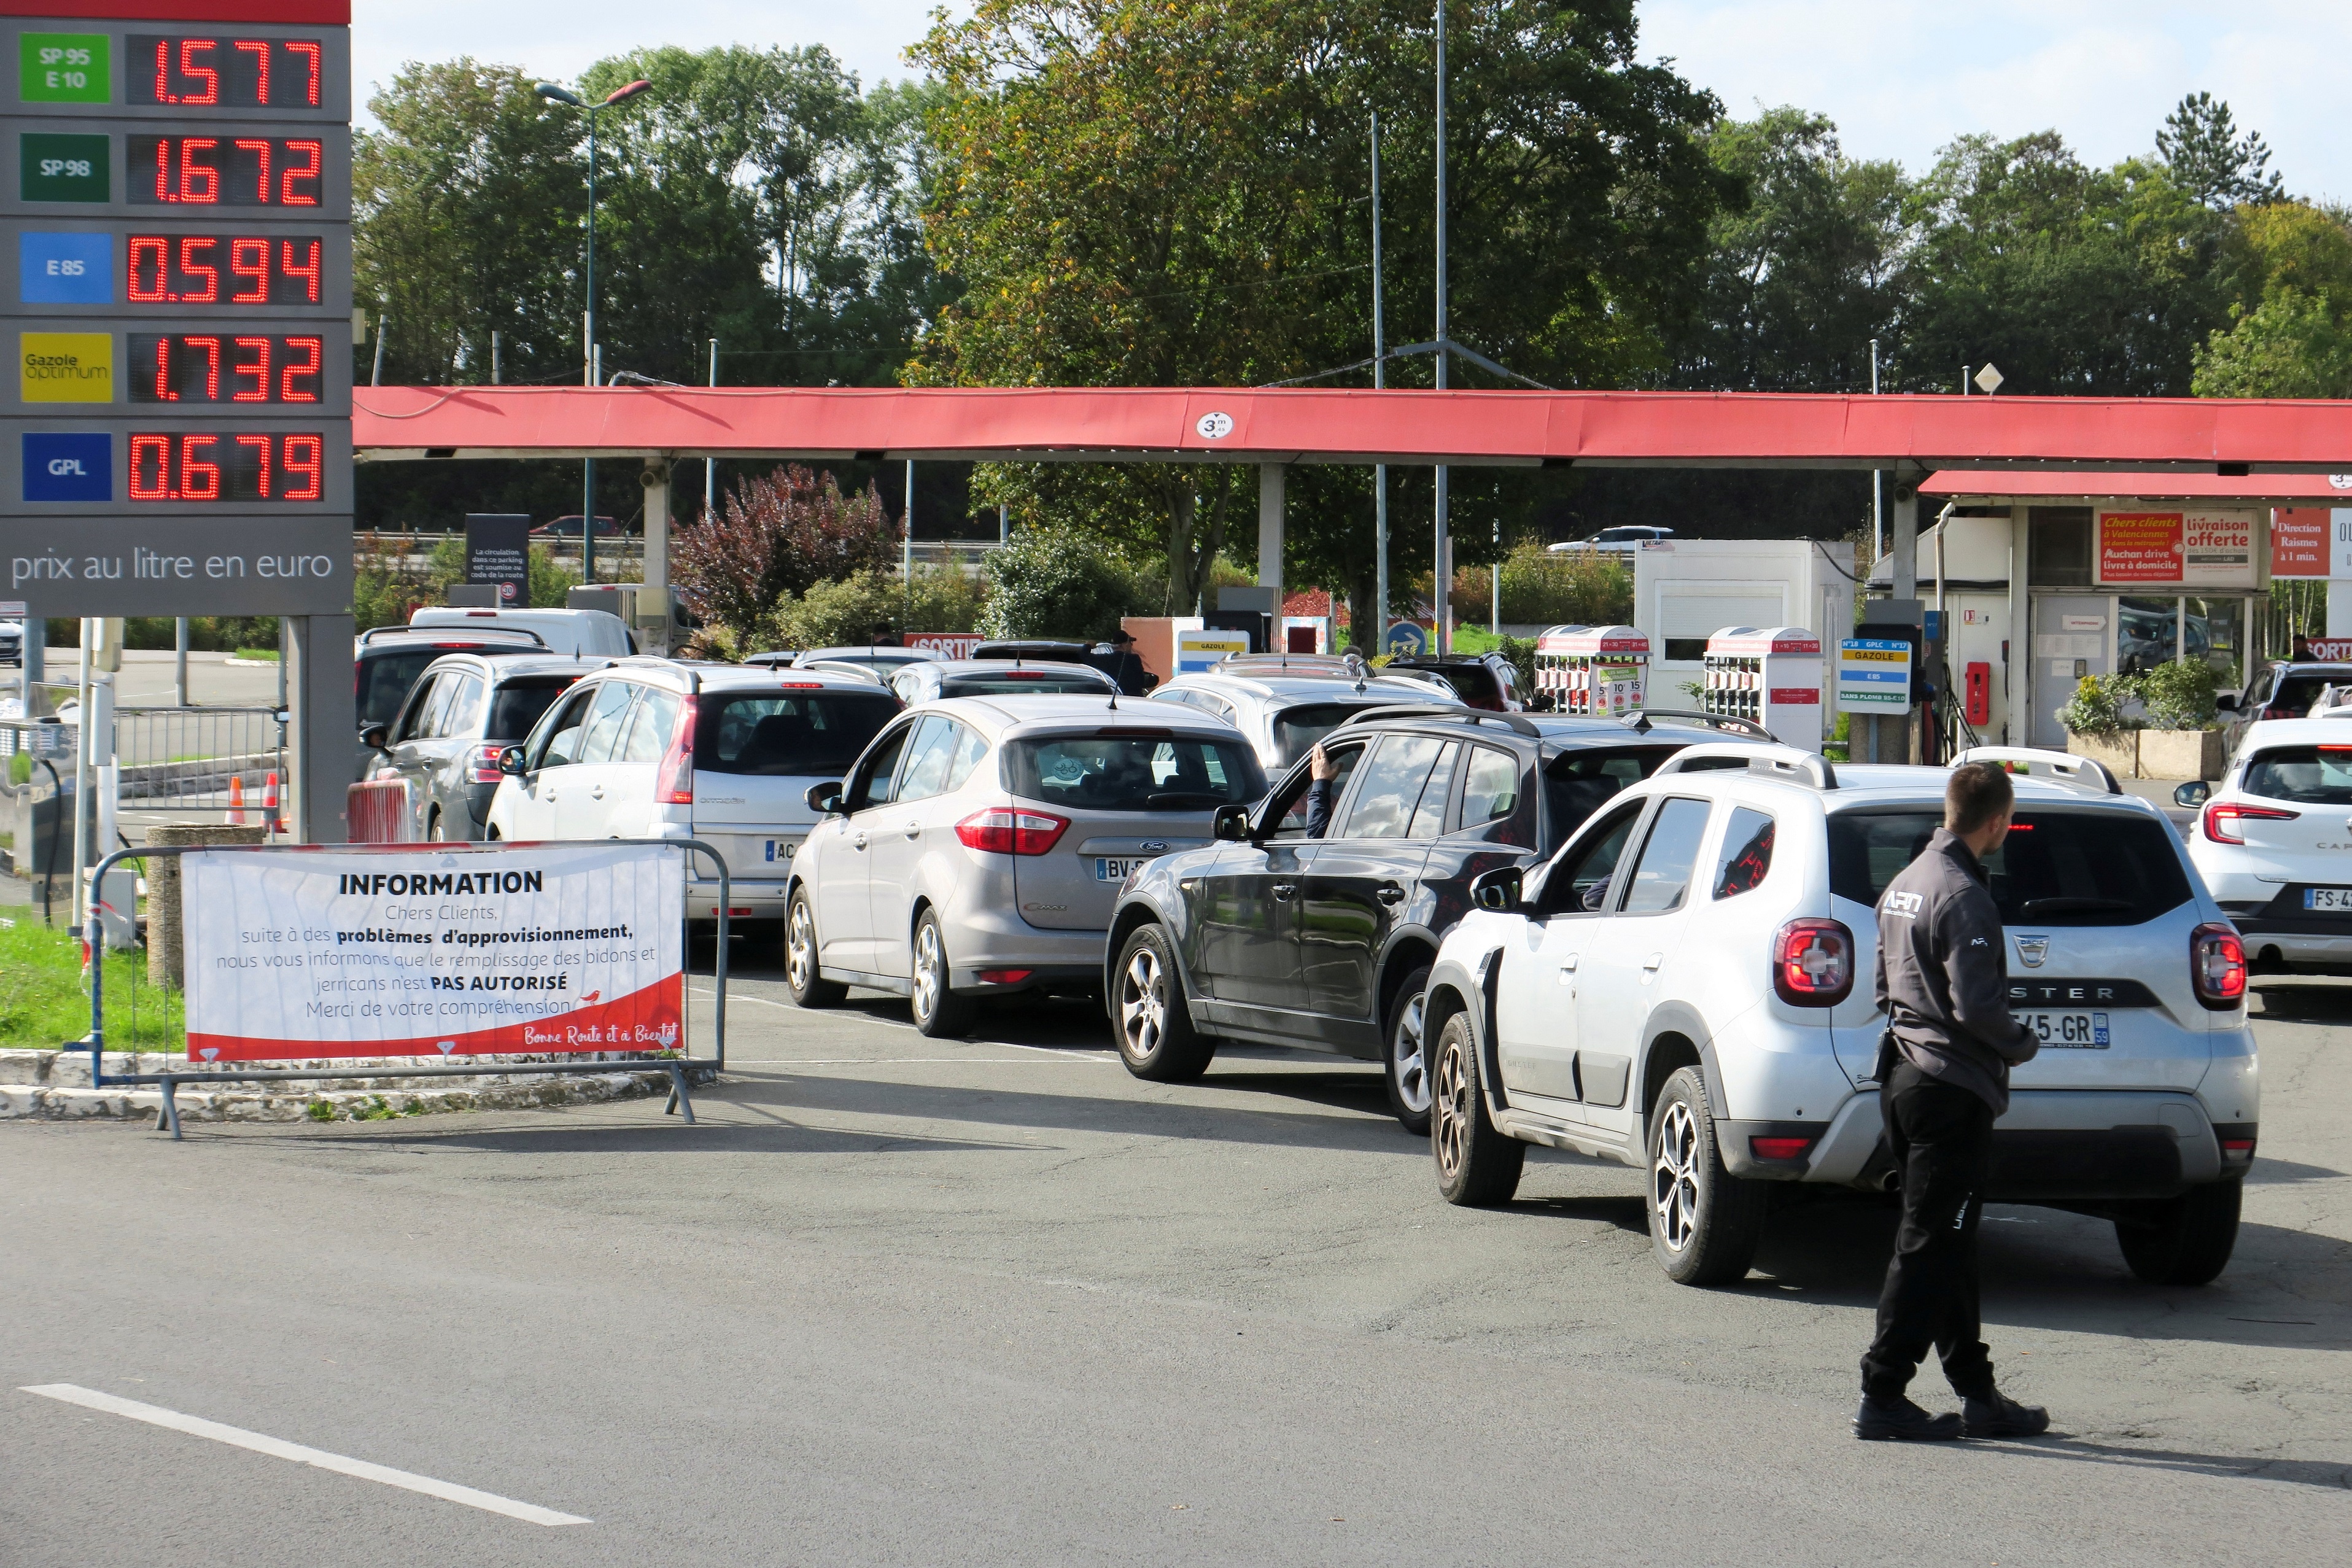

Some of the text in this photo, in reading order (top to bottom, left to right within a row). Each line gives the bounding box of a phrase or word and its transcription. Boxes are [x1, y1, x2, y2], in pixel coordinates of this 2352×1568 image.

[155, 40, 321, 106] 1.577
[155, 139, 321, 205] 1.672
[128, 238, 320, 303] 0.594
[26, 354, 78, 367] Gazole
[26, 365, 107, 381] optimum
[156, 337, 320, 402] 1.732
[1204, 420, 1216, 432] 3
[48, 459, 87, 476] GPL
[129, 435, 320, 500] 0.679
[2105, 517, 2177, 527] Chers clients
[2187, 518, 2248, 530] livraison
[2278, 523, 2321, 532] Direction
[2187, 532, 2248, 546] offerte
[2281, 537, 2318, 546] Raismes
[2105, 549, 2169, 558] Auchan drive
[2281, 551, 2318, 561] à 1 min.
[12, 547, 333, 589] prix au litre en euro
[2104, 561, 2125, 569] livre
[2136, 561, 2177, 569] domicile
[340, 871, 542, 895] INFORMATION
[2315, 890, 2352, 907] FS-4
[385, 905, 497, 921] Chers Clients,
[242, 928, 282, 943] suite
[287, 928, 297, 942] à
[303, 928, 330, 942] des
[336, 928, 432, 945] problèmes
[217, 947, 655, 970] nous vous informons que le remplissage des bidons et
[316, 971, 567, 996] jerricans n'est PAS AUTORISÉ
[306, 1001, 354, 1018] Merci
[361, 999, 382, 1016] de
[388, 1001, 433, 1015] votre
[524, 1022, 678, 1046] Bonne Route et à Bientôt
[2011, 1015, 2090, 1041] 5-GR
[2095, 1031, 2108, 1042] 59
